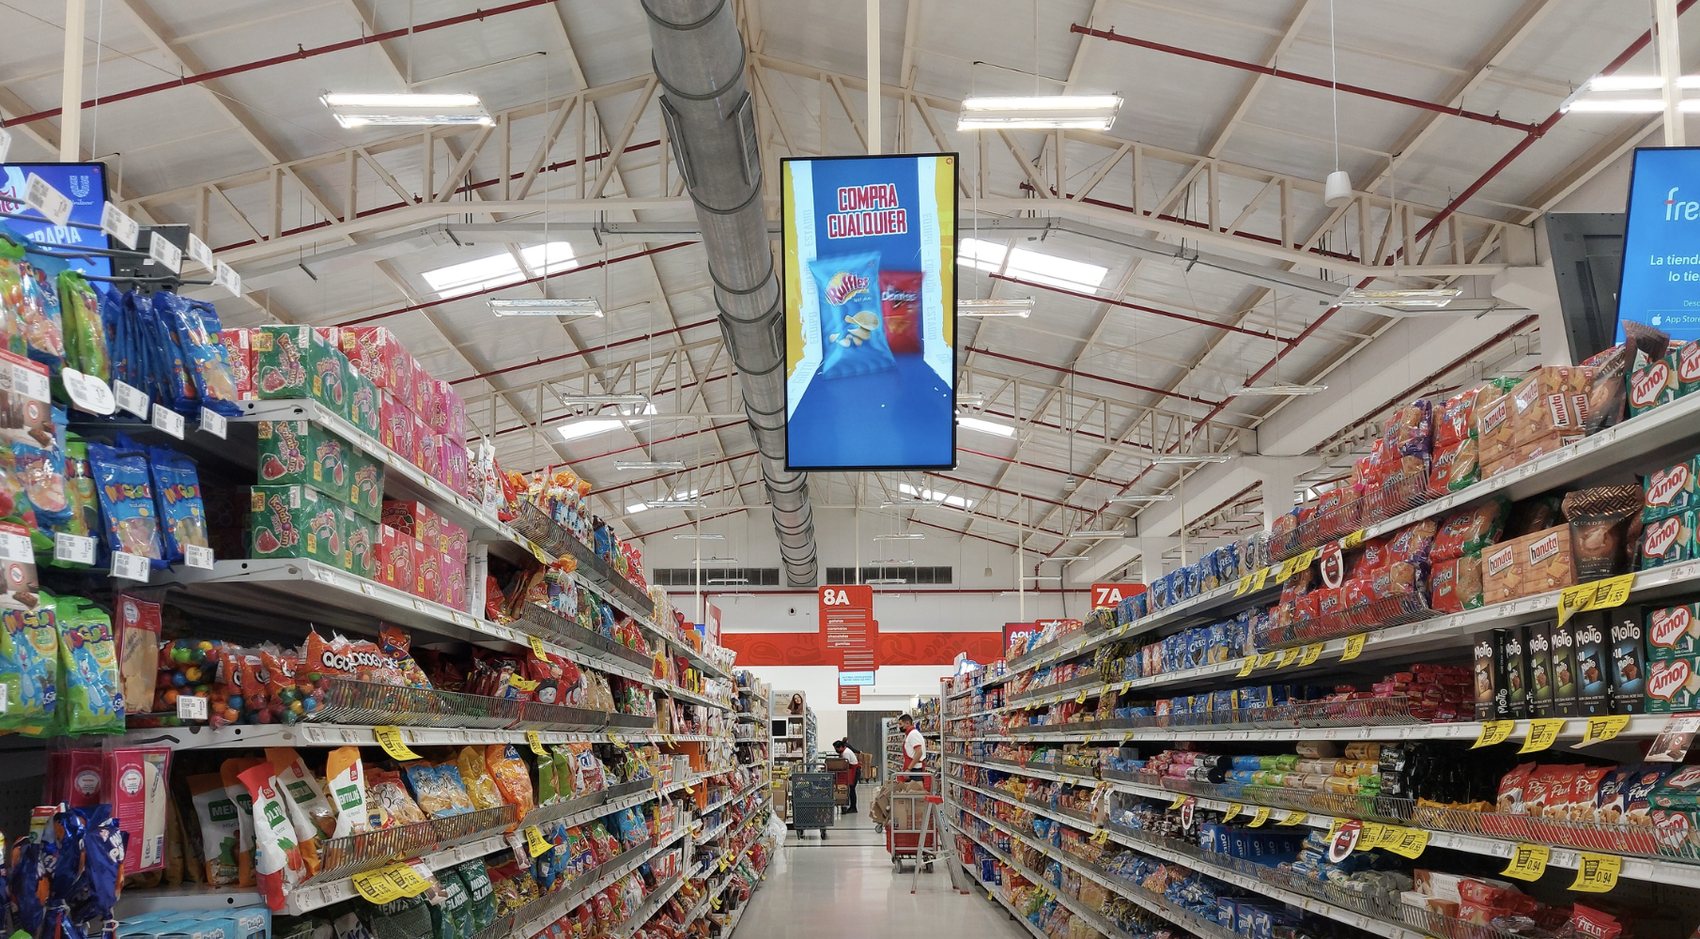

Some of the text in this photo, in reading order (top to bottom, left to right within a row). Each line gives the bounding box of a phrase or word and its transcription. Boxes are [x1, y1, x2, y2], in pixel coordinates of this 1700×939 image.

[838, 184, 898, 211] COMPRA
[26, 226, 82, 244] RAPIA
[827, 210, 908, 238] CUALQUIER
[1650, 254, 1663, 266] La
[1669, 271, 1700, 282] lo tie
[827, 273, 869, 306] Ruffles
[1665, 316, 1682, 324] App
[1637, 365, 1664, 402] Amor
[1485, 405, 1506, 431] hanuta
[1553, 396, 1567, 425] hanuta
[1652, 468, 1683, 501] Amor
[1648, 520, 1676, 552] Amor
[1530, 537, 1558, 561] hanuta
[1489, 550, 1512, 573] hanuta
[824, 588, 850, 606] 8A
[1097, 588, 1123, 605] 7A
[1576, 625, 1602, 647] MOTTO
[1611, 620, 1640, 643] MOTTO
[1656, 610, 1685, 641] Amor
[1653, 663, 1685, 692] Amor
[1527, 860, 1540, 872] 0.94
[1596, 871, 1612, 883] 0.94
[1578, 917, 1602, 936] FIELD
